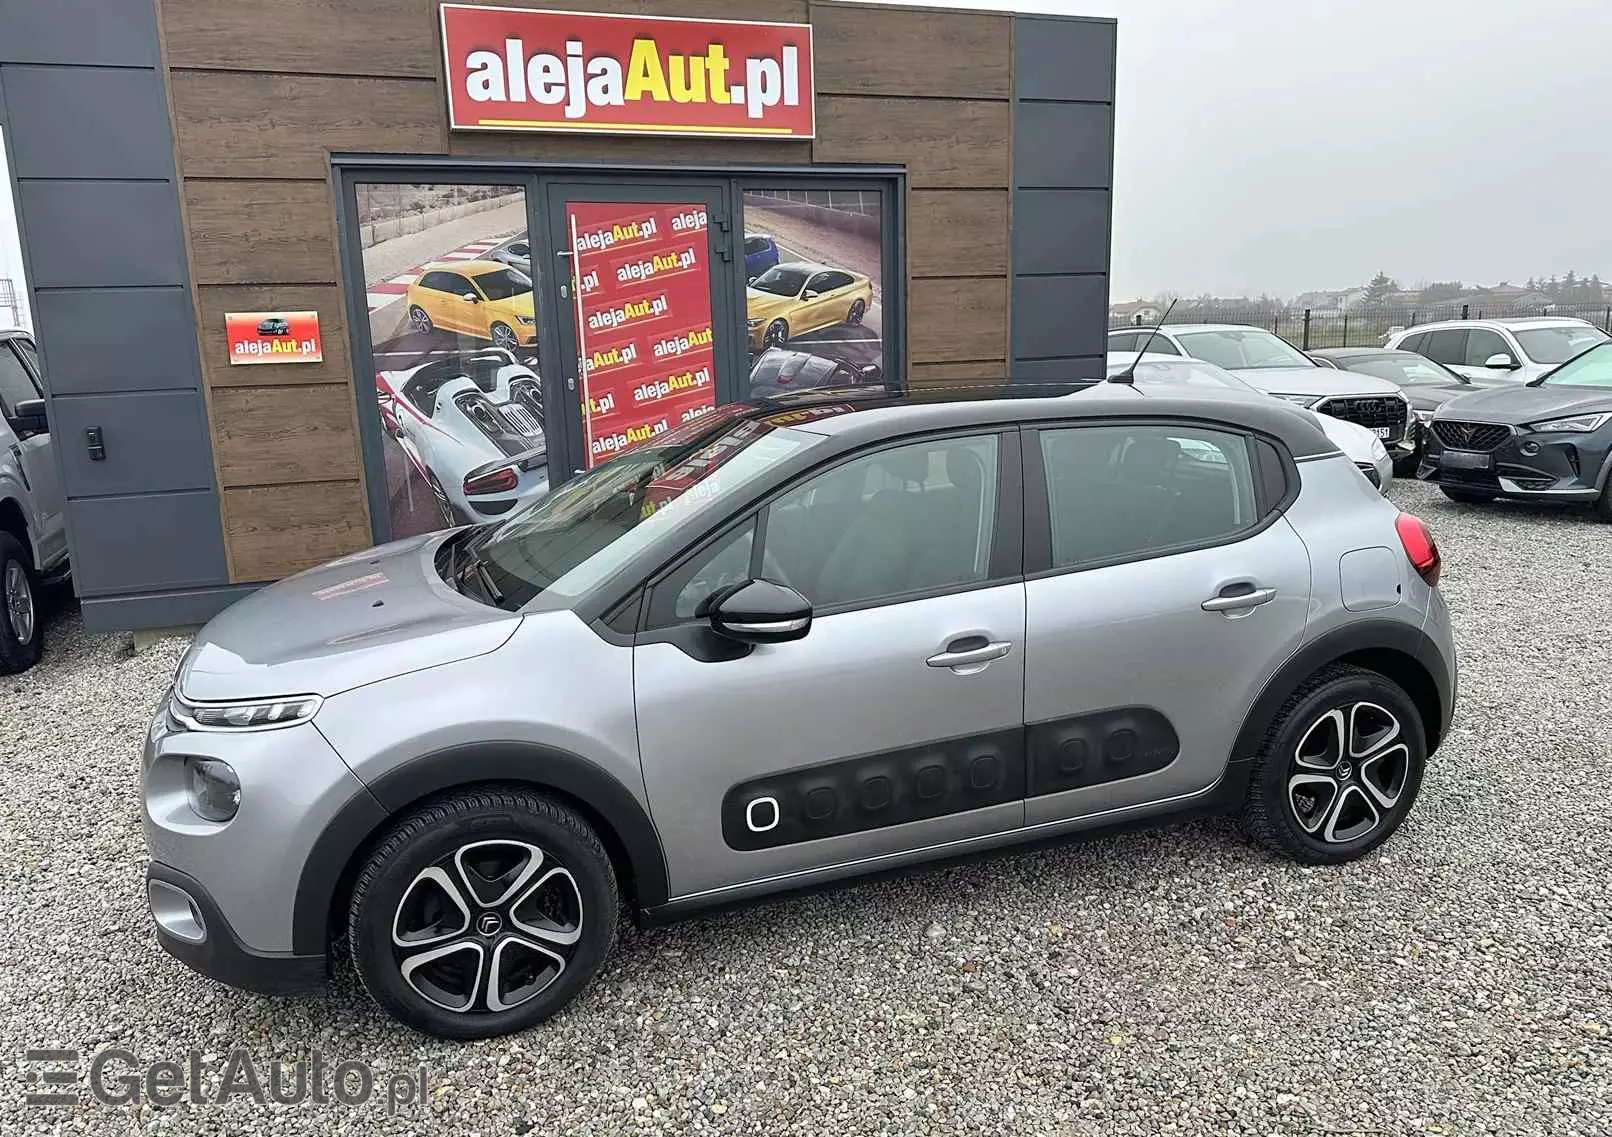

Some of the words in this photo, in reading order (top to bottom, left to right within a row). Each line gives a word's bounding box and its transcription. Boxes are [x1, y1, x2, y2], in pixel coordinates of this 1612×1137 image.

[465, 38, 799, 119] alejaAut.pl
[577, 217, 658, 250] alejaAut.pl
[671, 210, 707, 231] aleja
[617, 248, 696, 282] alejaAut.pl
[588, 294, 668, 329] alejaAut.pl
[235, 338, 316, 357] alejaAut.pl
[653, 327, 712, 357] alejaAut
[634, 367, 710, 402] alejaAut.pl
